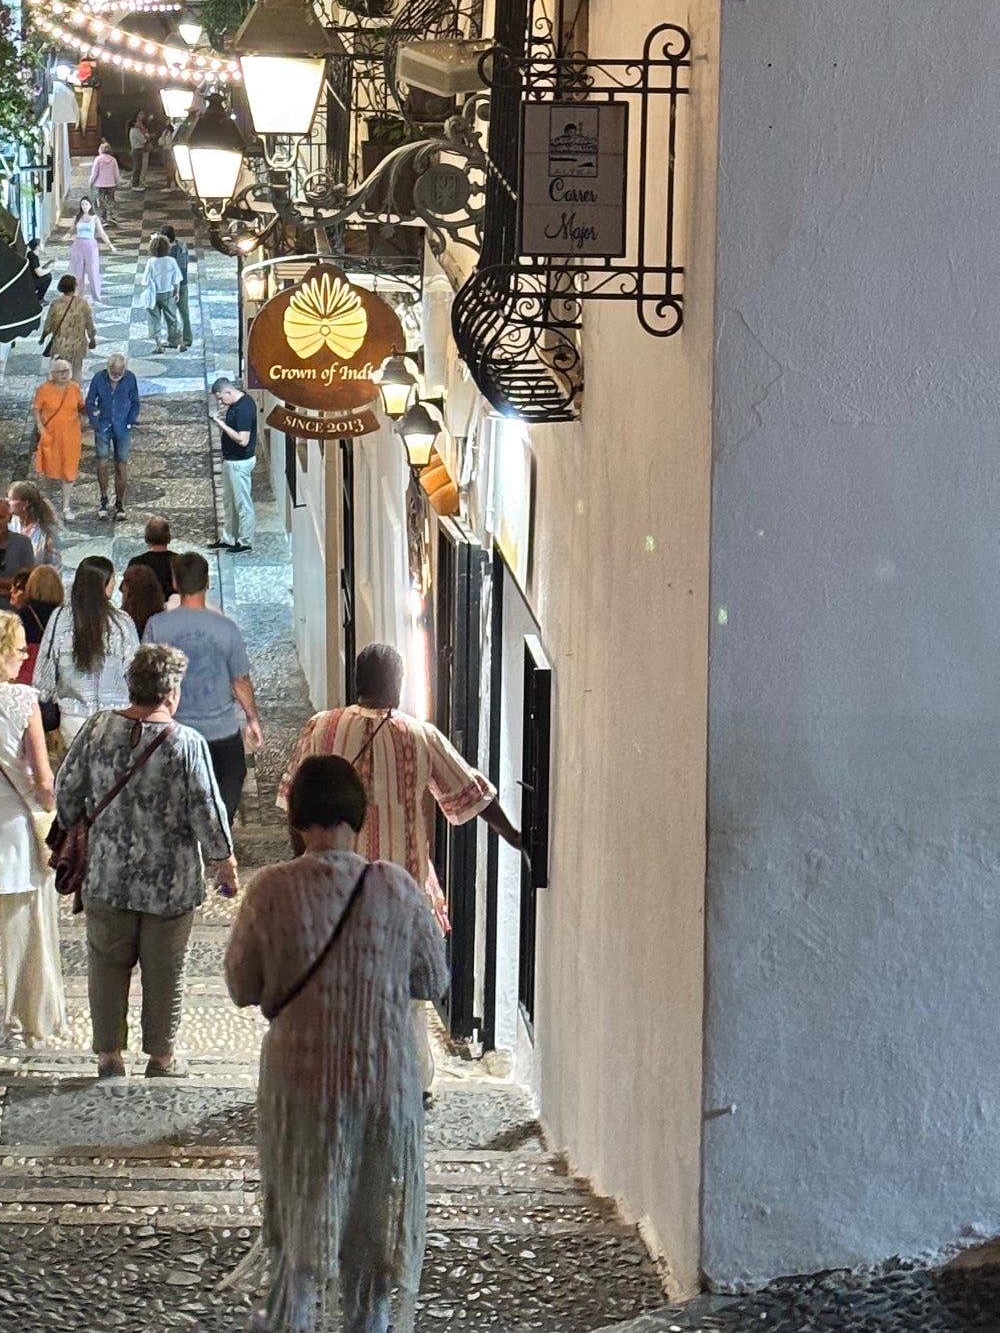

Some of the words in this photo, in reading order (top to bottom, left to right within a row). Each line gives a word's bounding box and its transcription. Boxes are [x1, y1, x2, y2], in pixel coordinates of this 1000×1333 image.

[549, 177, 598, 203] Carrer
[269, 364, 316, 380] Crown
[321, 362, 339, 386] of
[339, 362, 375, 380] Indi
[283, 415, 324, 433] SINCE
[326, 418, 365, 433] 2013
